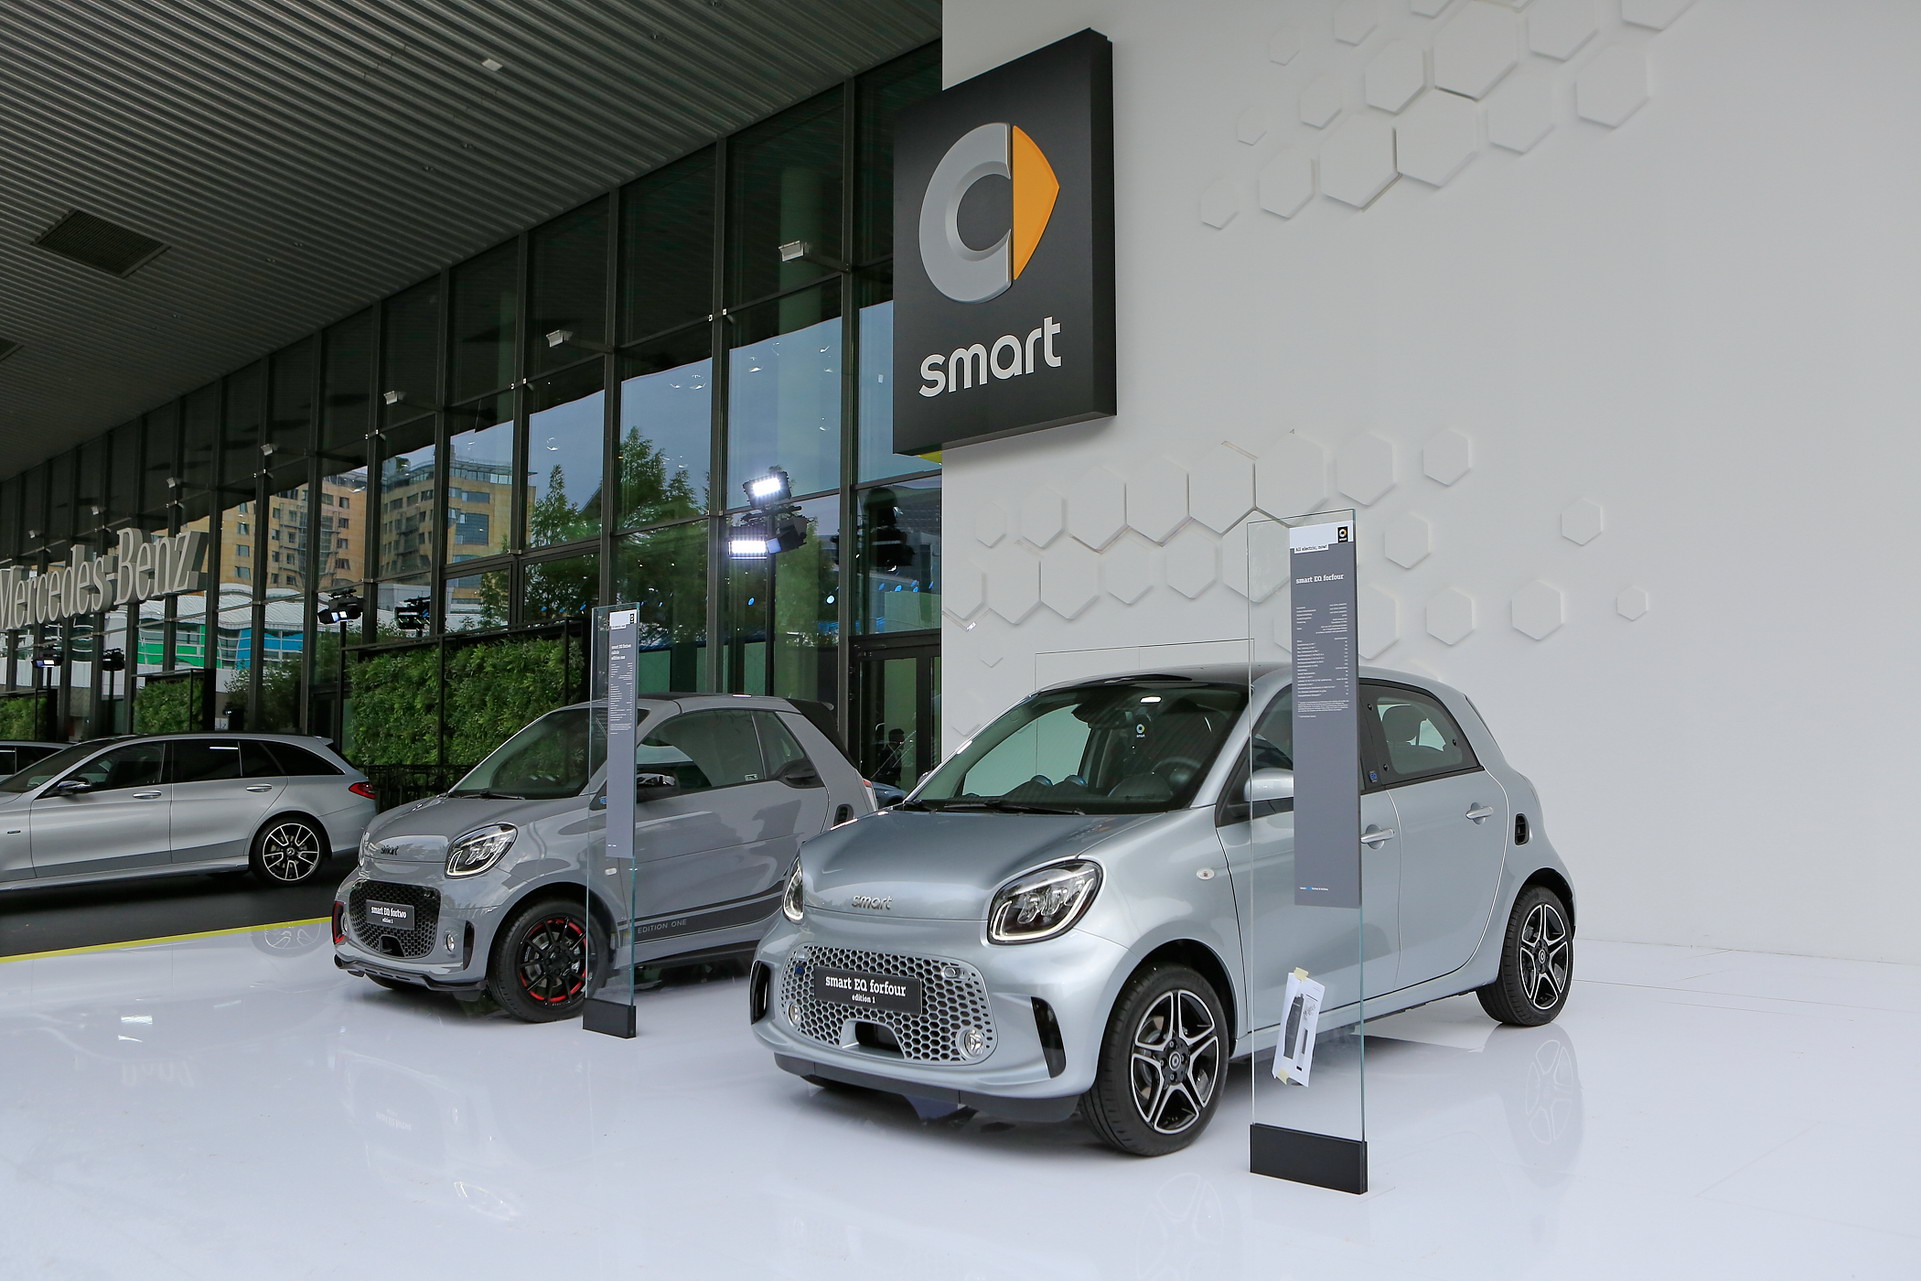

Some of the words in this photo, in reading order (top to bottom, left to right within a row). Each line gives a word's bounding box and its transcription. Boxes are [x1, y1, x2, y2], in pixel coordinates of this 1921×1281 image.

[918, 316, 1062, 398] smart
[0, 527, 196, 631] Mercedes-Benz
[1296, 576, 1313, 584] smart
[1323, 573, 1344, 581] forfour
[852, 895, 894, 910] smart
[371, 906, 383, 915] smart
[637, 922, 668, 934] EDITION
[671, 919, 687, 928] ONE
[825, 976, 852, 989] smart
[853, 978, 868, 992] EQ
[869, 979, 907, 997] forfour
[852, 993, 871, 1003] edition
[872, 996, 876, 1004] 1
